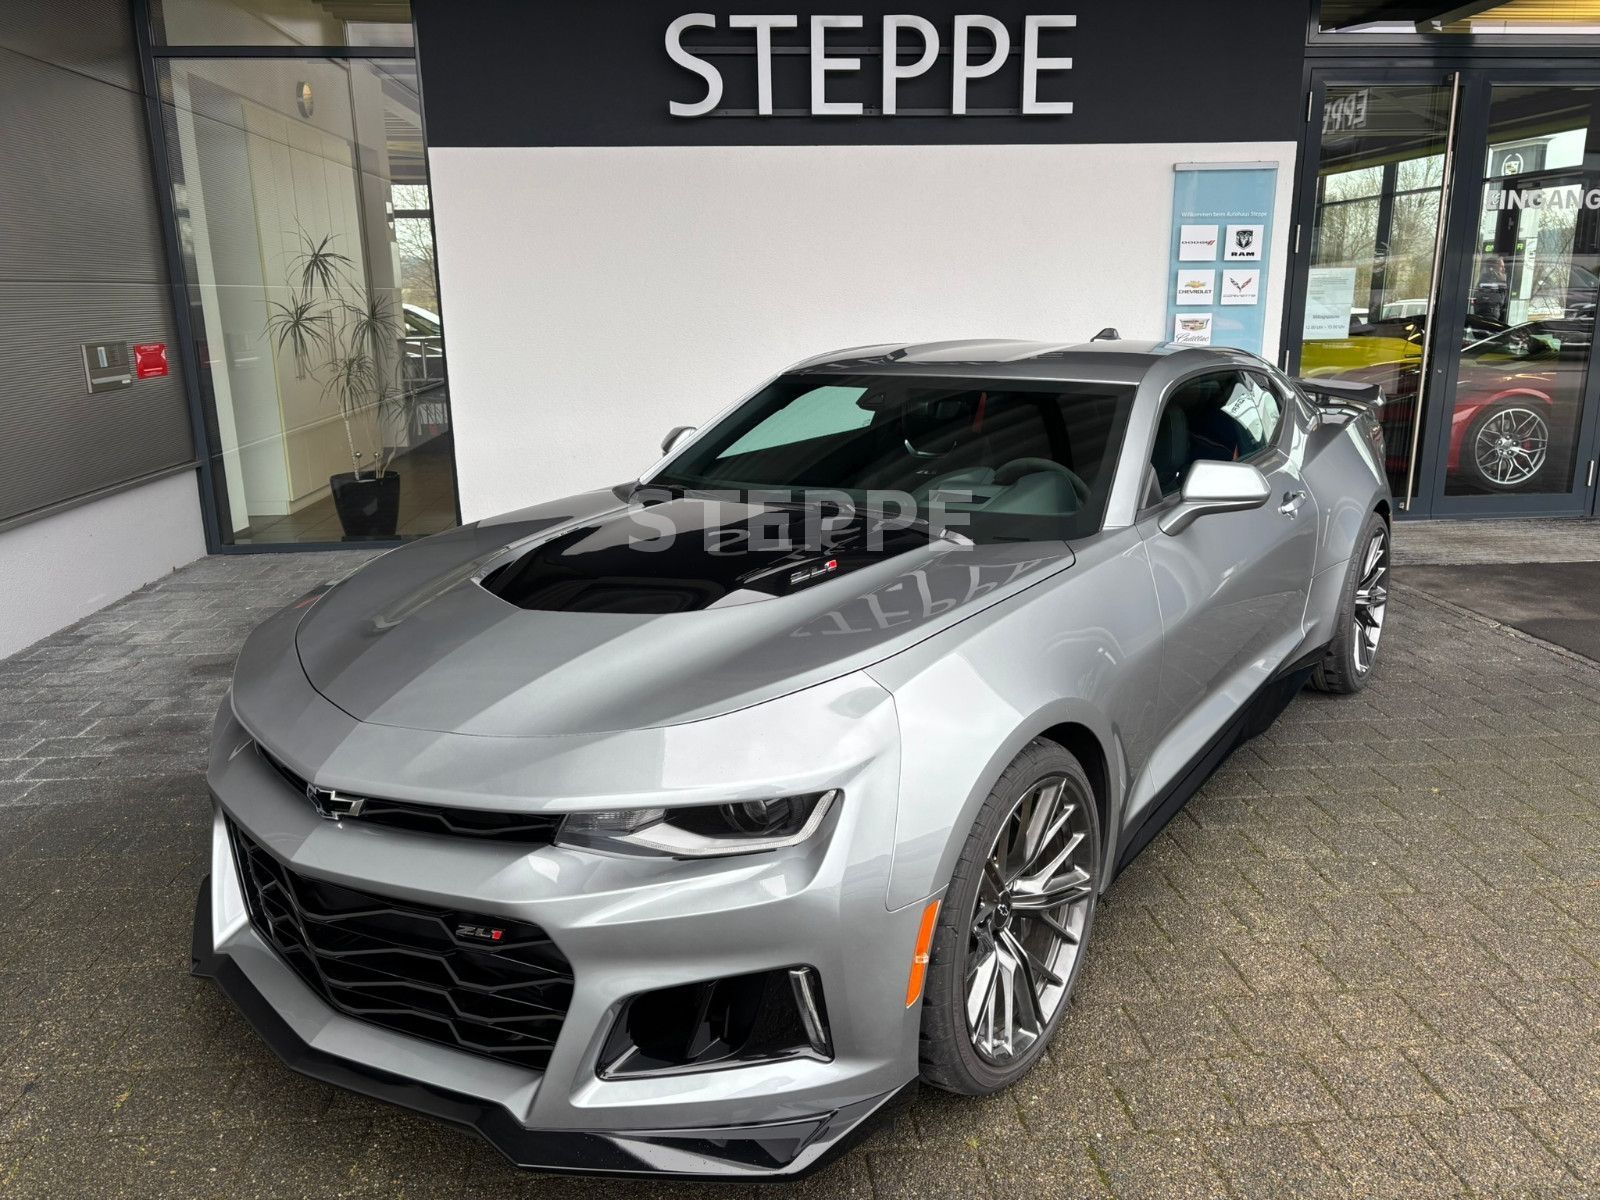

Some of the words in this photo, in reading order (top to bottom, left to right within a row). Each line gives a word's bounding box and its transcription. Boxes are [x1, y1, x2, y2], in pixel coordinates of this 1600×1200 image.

[665, 12, 1077, 117] STEPPE
[1486, 188, 1600, 211] EINGANG
[1175, 332, 1209, 344] Cadillac
[456, 924, 504, 941] ZL1
